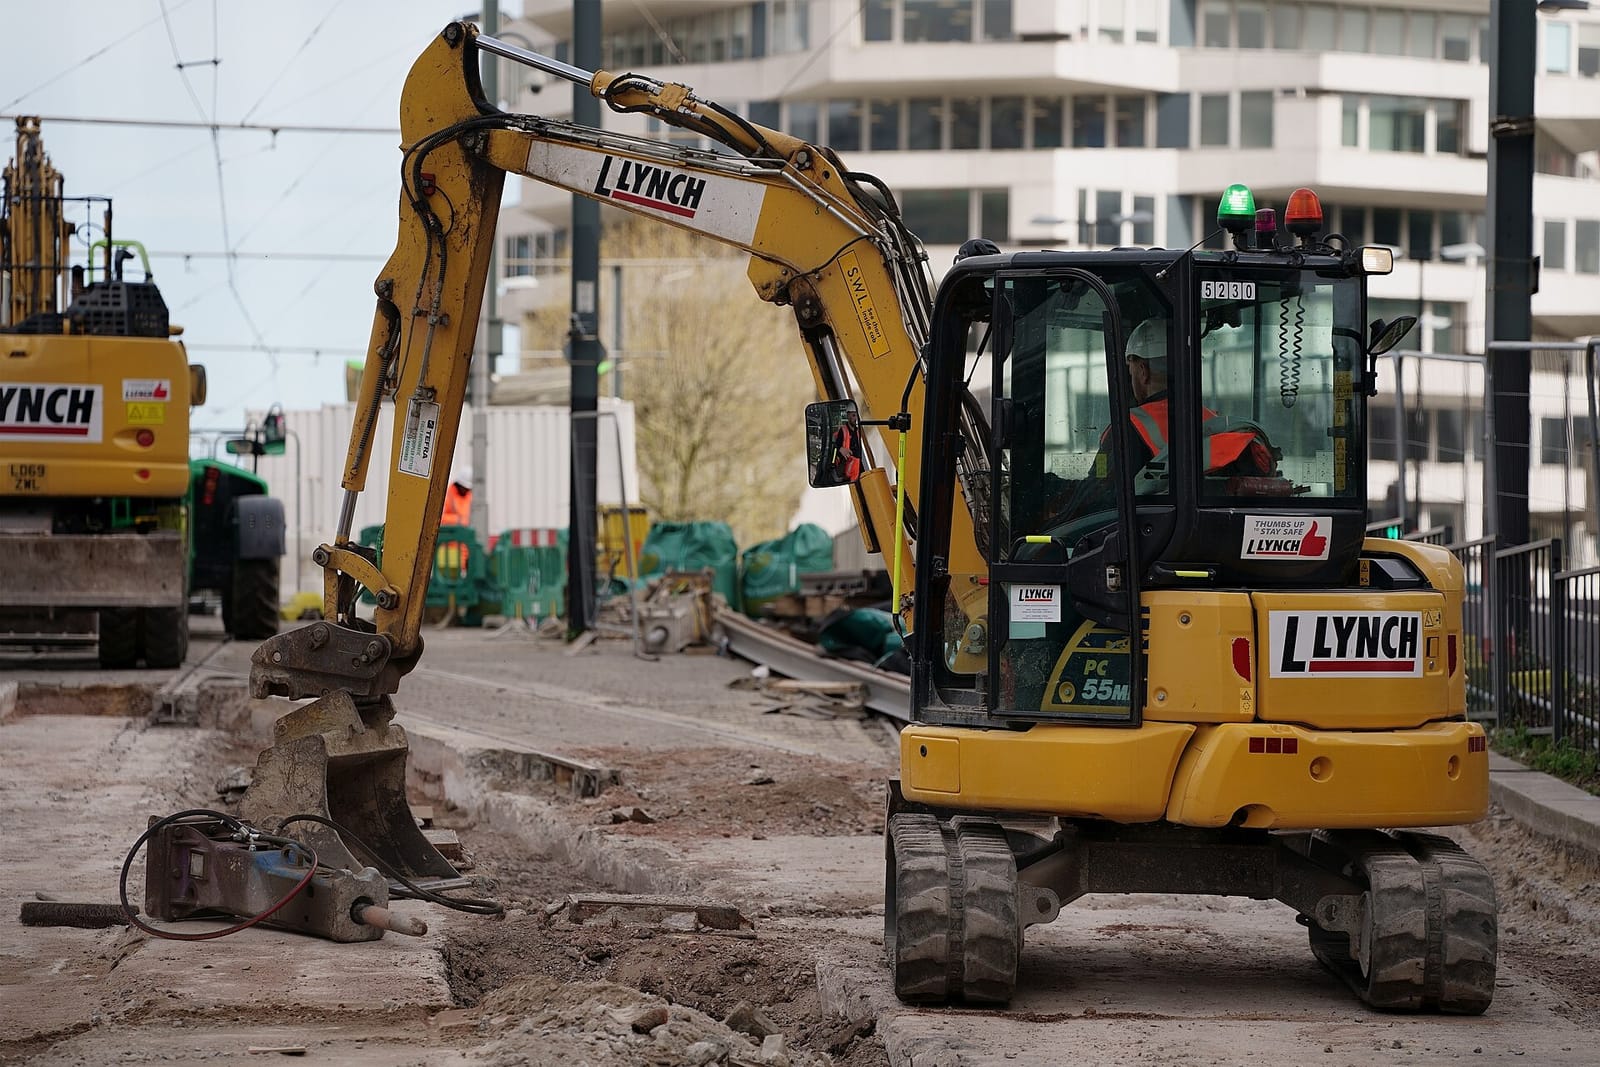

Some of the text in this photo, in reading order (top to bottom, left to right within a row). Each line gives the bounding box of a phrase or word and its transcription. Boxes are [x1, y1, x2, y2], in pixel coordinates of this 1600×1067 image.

[616, 160, 707, 210] LYNCH
[847, 267, 868, 309] S.W.L.
[1205, 282, 1252, 298] 5230
[0, 387, 95, 424] YNCH
[422, 430, 431, 459] TEFRA
[1255, 520, 1291, 528] THUMBS
[1256, 539, 1301, 551] LYNCH
[1024, 589, 1053, 599] LYNCH
[1312, 615, 1419, 659] LYNCH
[1083, 659, 1109, 676] PC
[1081, 679, 1130, 701] 55M
